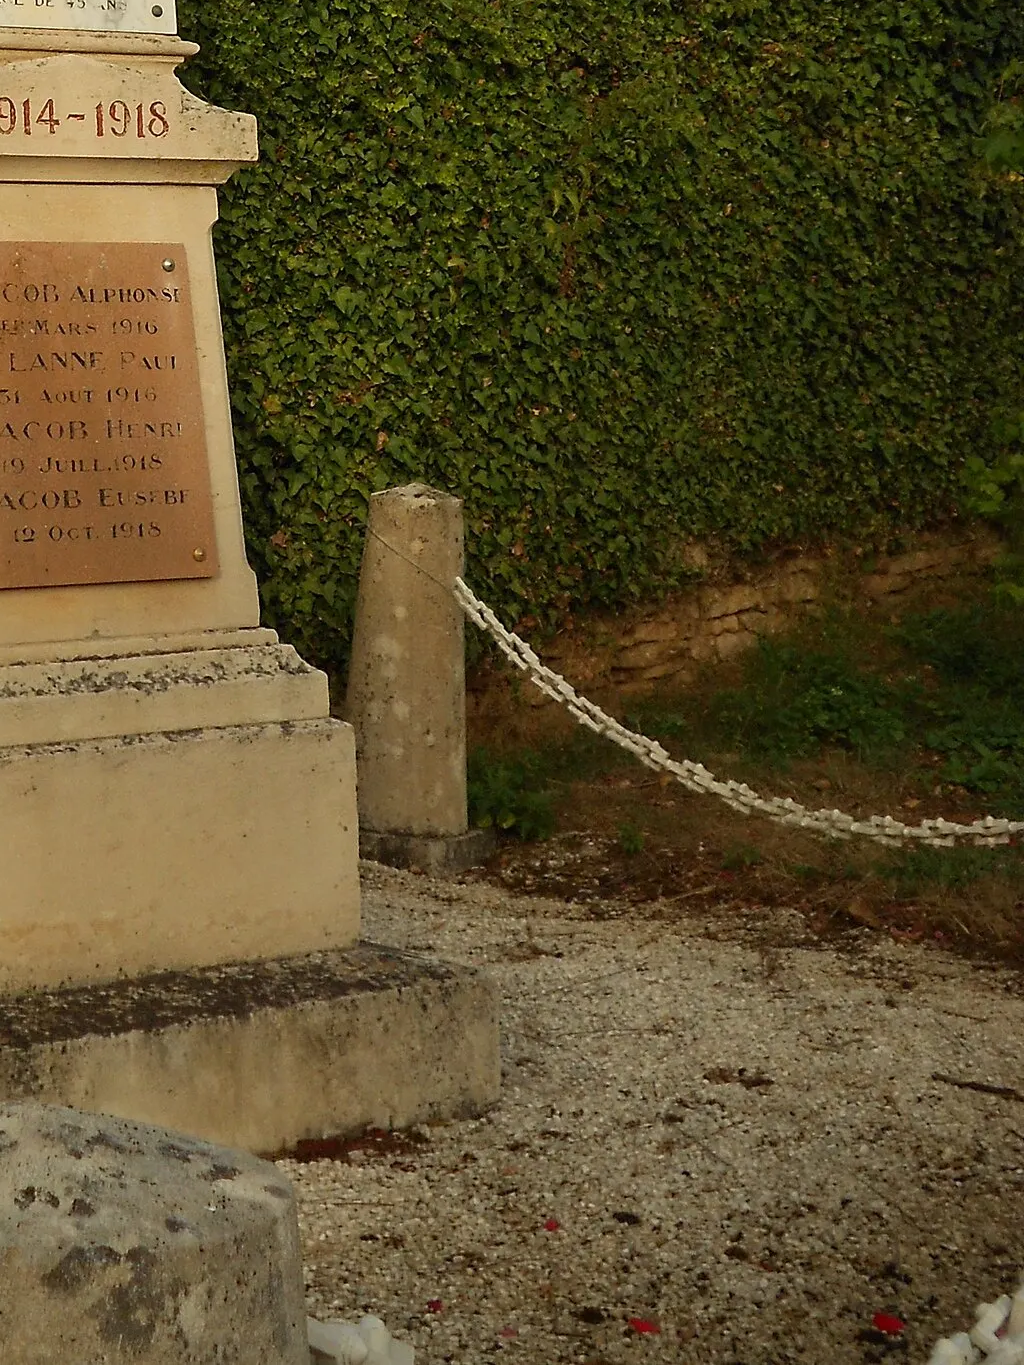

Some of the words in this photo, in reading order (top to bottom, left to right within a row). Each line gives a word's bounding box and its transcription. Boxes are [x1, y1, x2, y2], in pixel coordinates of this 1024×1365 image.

[70, 286, 183, 304] ALPHONSE
[34, 319, 97, 336] MARS
[112, 318, 158, 335] 1916
[41, 389, 94, 405] AOUT
[107, 386, 157, 403] 1916
[106, 419, 184, 439] HENRI
[2, 457, 25, 474] 19
[13, 526, 37, 543] 12
[111, 520, 162, 540] 1918
